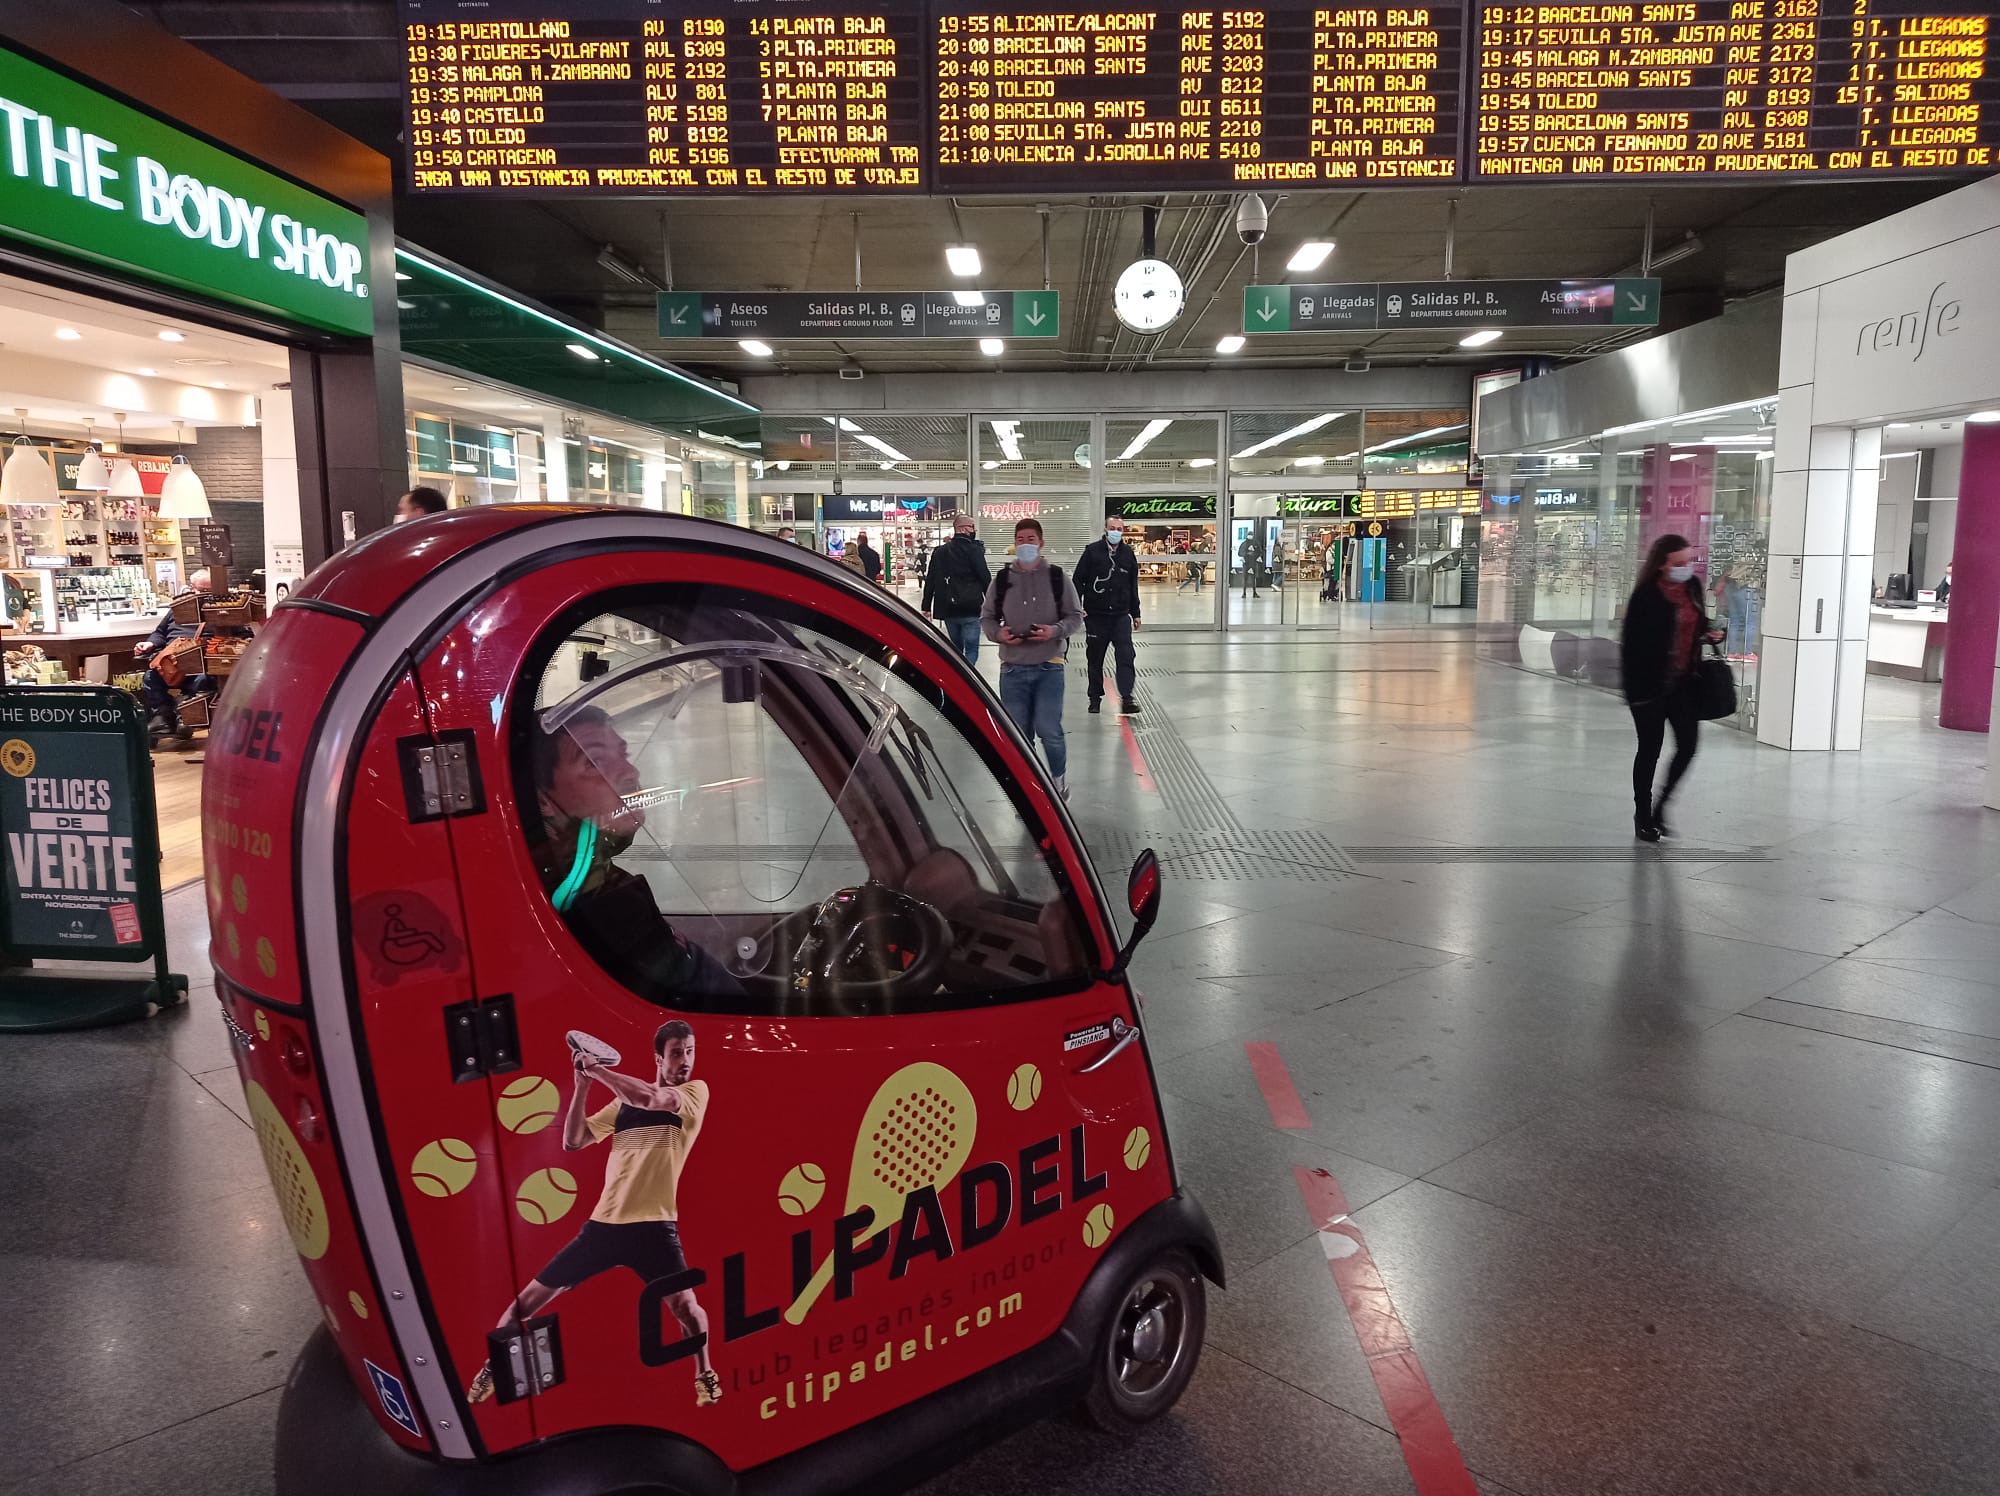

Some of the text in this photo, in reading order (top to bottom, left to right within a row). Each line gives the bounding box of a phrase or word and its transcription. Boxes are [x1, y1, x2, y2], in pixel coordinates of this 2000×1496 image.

[406, 16, 885, 41] 19:15 PUERTOLLANO AV 8190 14 PLANTA BAJA
[939, 9, 1429, 34] 19:55 ALICANTE/ALACANT AVE 5192 PLANTA BAJA
[408, 38, 896, 63] 19:30 FIGUERES-VILAFANT AVL 6309 3 PLTA.PRIMERA
[938, 31, 1438, 55] 20:00 BARCELONA SANTS AVE 3201 PLTA.PRIMERA
[1481, 38, 1985, 68] 19:45 MALAGA M.ZAMBRANO AVE 2173 7 T. LLEGADAS
[409, 60, 896, 84] 19:35 MALAGA M.ZAMBRANO AVE 2192 5 PLTA.PRIMERA
[938, 74, 1426, 99] 20:50 TOLEDO AV 8212 PLANTA BAJA
[1480, 82, 1971, 111] 19:54 TOLEDO AV 8193 15 T. SALIDAS
[411, 103, 887, 125] 19:40 CASTELLO AVE 5198 7 PLANTA BAJA
[939, 117, 1435, 142] 21:00 SEVILLA STA. JUSTA AVE 2210 PLTA.PRIMERA
[1478, 136, 1530, 153] 19:57
[1533, 135, 1596, 153] CUENCA
[1604, 134, 1688, 152] FERNANDO
[1722, 133, 1755, 150] AVE
[1763, 131, 1806, 150] 5181
[1860, 129, 1878, 147] T.
[1890, 126, 1978, 146] LLEGADAS
[939, 138, 1424, 163] 21:10 VALENCIA J.SOROLLA AVE 5410 PLANTA BAJA
[1480, 157, 1563, 175] MANTENGA
[1572, 156, 1604, 173] UNA
[1612, 155, 1706, 173] DISTANCIA
[1714, 153, 1819, 171] PRUDENCIAL
[1828, 151, 1862, 169] CON
[1870, 150, 1893, 168] EL
[1902, 148, 1958, 167] RESTO
[1966, 147, 1990, 165] DE
[0, 96, 124, 211] THE
[137, 156, 265, 259] BODY
[730, 303, 768, 315] Aseos
[808, 303, 854, 315] Salidas
[859, 303, 875, 315] Pl.
[880, 303, 893, 315] B.
[1323, 297, 1375, 310] Llegadas
[1411, 293, 1458, 306] Salidas
[1463, 292, 1480, 305] Pl.
[1486, 292, 1499, 304] B.
[1411, 310, 1452, 318] DEPARTURES
[1455, 309, 1483, 317] GROUND
[1856, 281, 1963, 362] renfe
[138, 460, 171, 473] REBAJAS
[850, 500, 897, 512] Mr. Blue
[1122, 498, 1194, 514] natura
[204, 541, 211, 549] 3
[30, 708, 75, 723] BODY
[24, 777, 112, 812] FELICES
[56, 817, 83, 829] DE
[8, 832, 137, 893] VERTE
[1070, 1028, 1095, 1039] Powered
[638, 1123, 1108, 1367] CLIPADEL
[812, 1288, 954, 1361] leganés
[970, 1237, 1068, 1297] indoor
[759, 1291, 1023, 1420] clipadel.com
